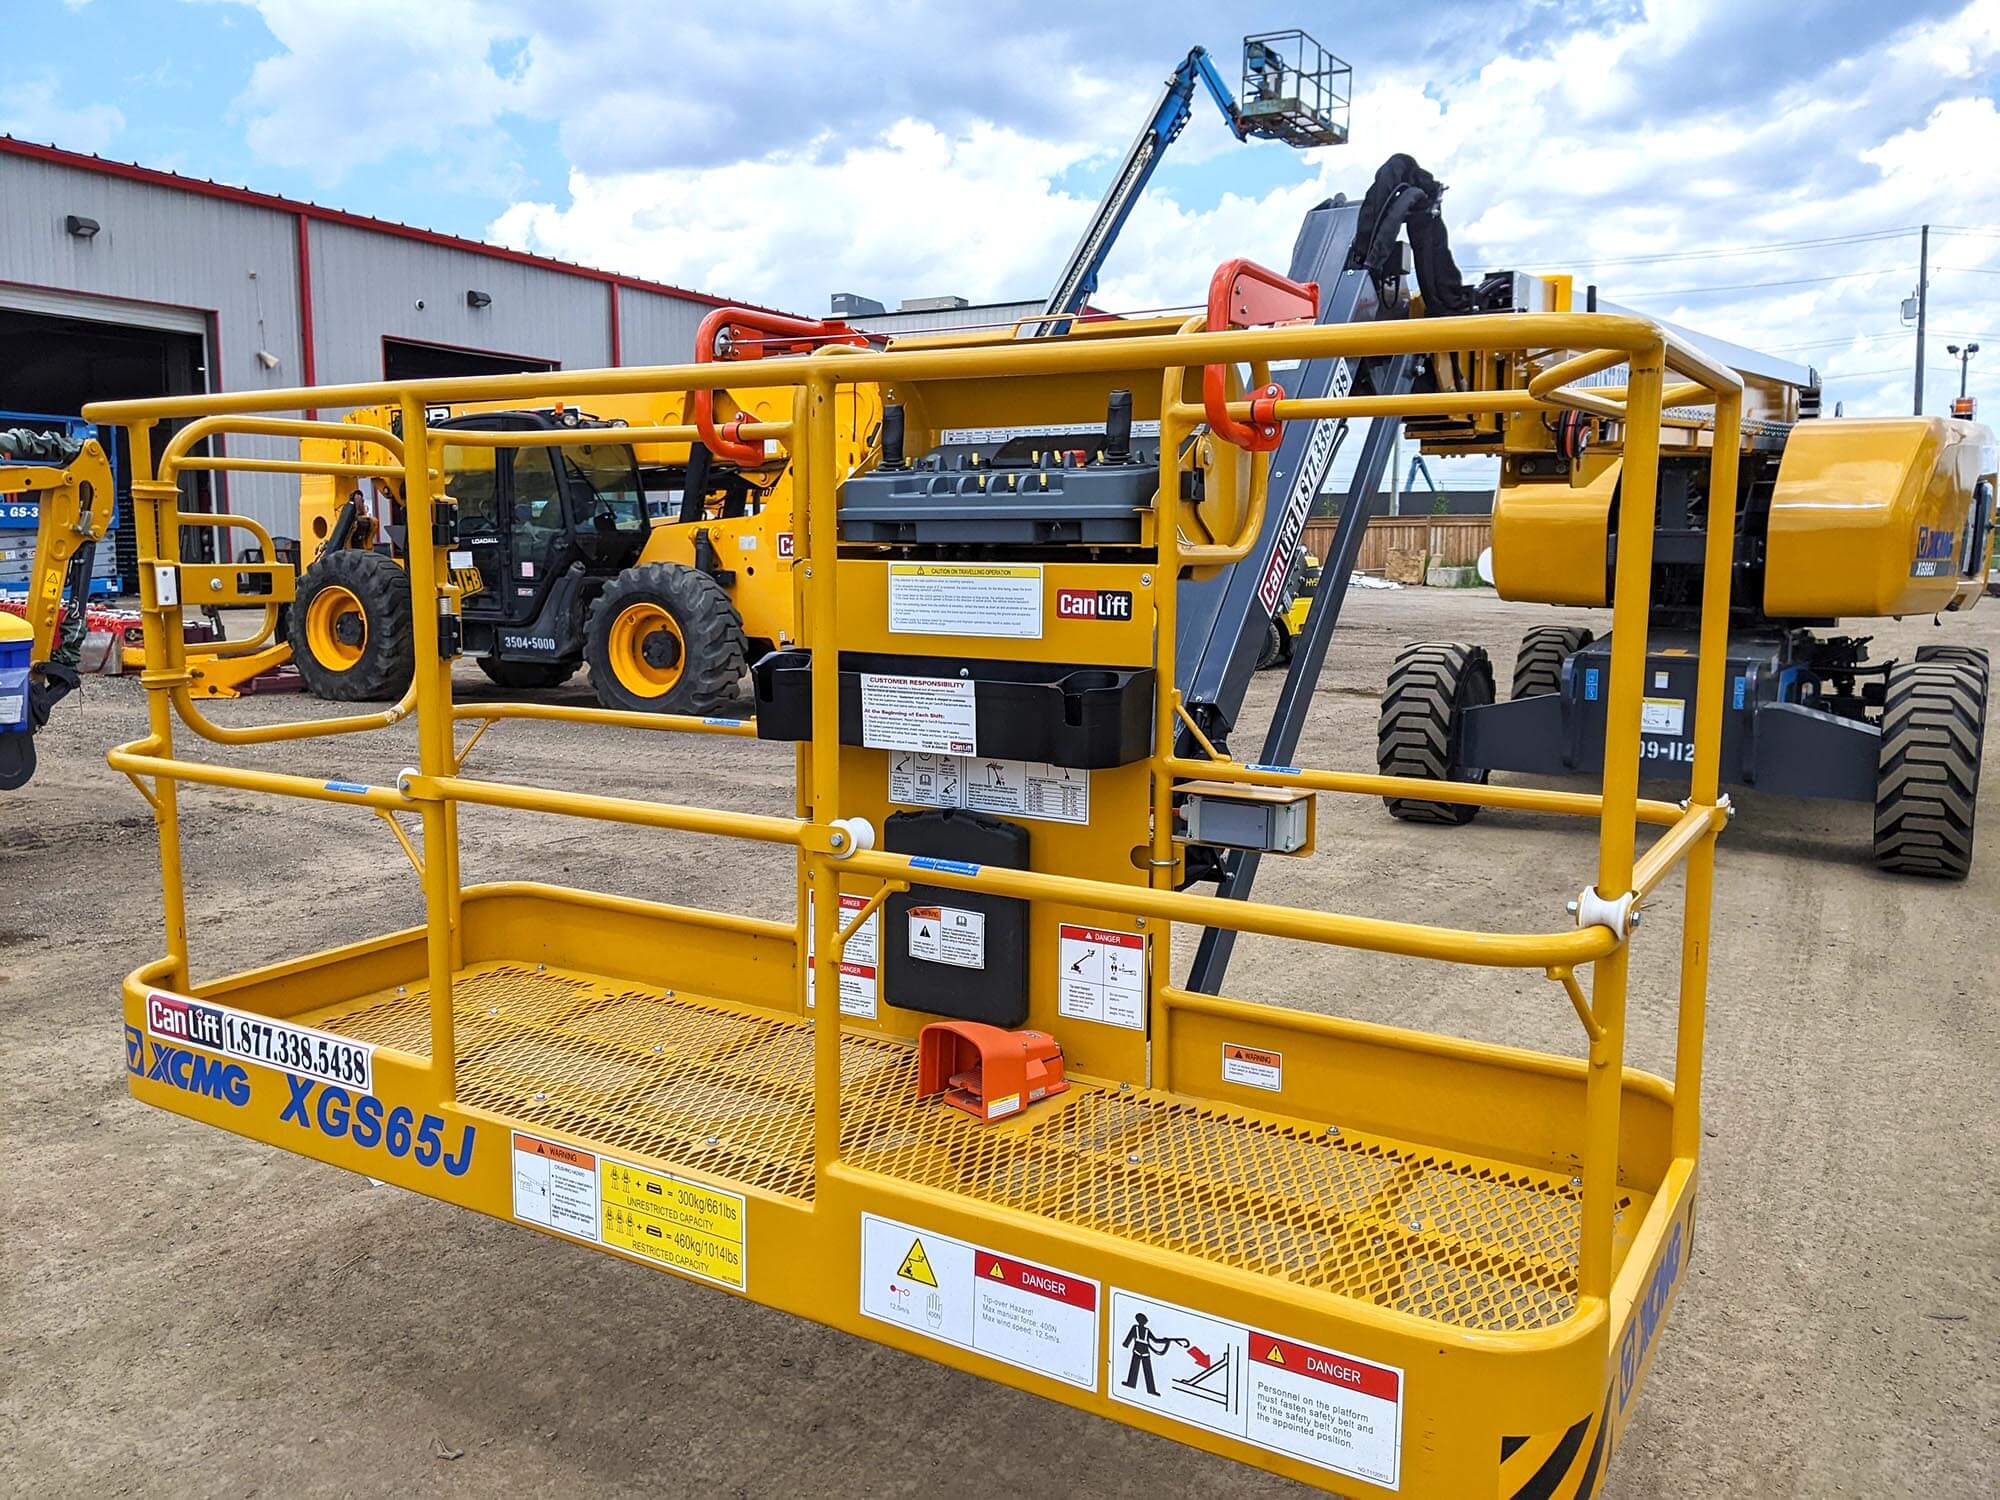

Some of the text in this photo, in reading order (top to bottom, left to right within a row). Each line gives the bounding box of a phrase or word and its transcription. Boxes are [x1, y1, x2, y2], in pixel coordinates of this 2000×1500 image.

[1293, 367, 1348, 520] 1.877.338.38
[1262, 508, 1299, 606] CanLift
[455, 568, 481, 594] JCB
[1060, 593, 1129, 616] CanLift
[869, 677, 965, 688] CUSTOMER RESPONSIBILITY
[1094, 933, 1121, 944] DANGER
[151, 1000, 221, 1045] CanLift
[226, 1018, 366, 1085] 1.877.338.5438
[147, 1041, 251, 1107] XCMG
[280, 1074, 476, 1176] XGS65J
[549, 1147, 577, 1162] WARNING
[626, 1196, 714, 1230] UNRESTRICTED CAPACITY
[678, 1189, 737, 1220] 300kg/661lbs
[632, 1240, 710, 1273] RESTRICTED CAPACITY
[674, 1232, 739, 1265] 460kg/1014lbs
[1022, 1272, 1066, 1296] DANGER
[982, 1303, 996, 1313] Max
[996, 1307, 1020, 1321] manual
[1040, 1321, 1057, 1333] 400N
[983, 1294, 1008, 1309] Tip-over
[982, 1313, 996, 1323] Max
[997, 1316, 1011, 1328] wind
[1307, 1356, 1361, 1384] DANGER
[1257, 1381, 1369, 1423] Personnel on the platform
[1257, 1393, 1374, 1435] must fasten safety belt and
[1257, 1401, 1352, 1438] fix the safety belt onto
[1257, 1412, 1354, 1450] the appointed position.
